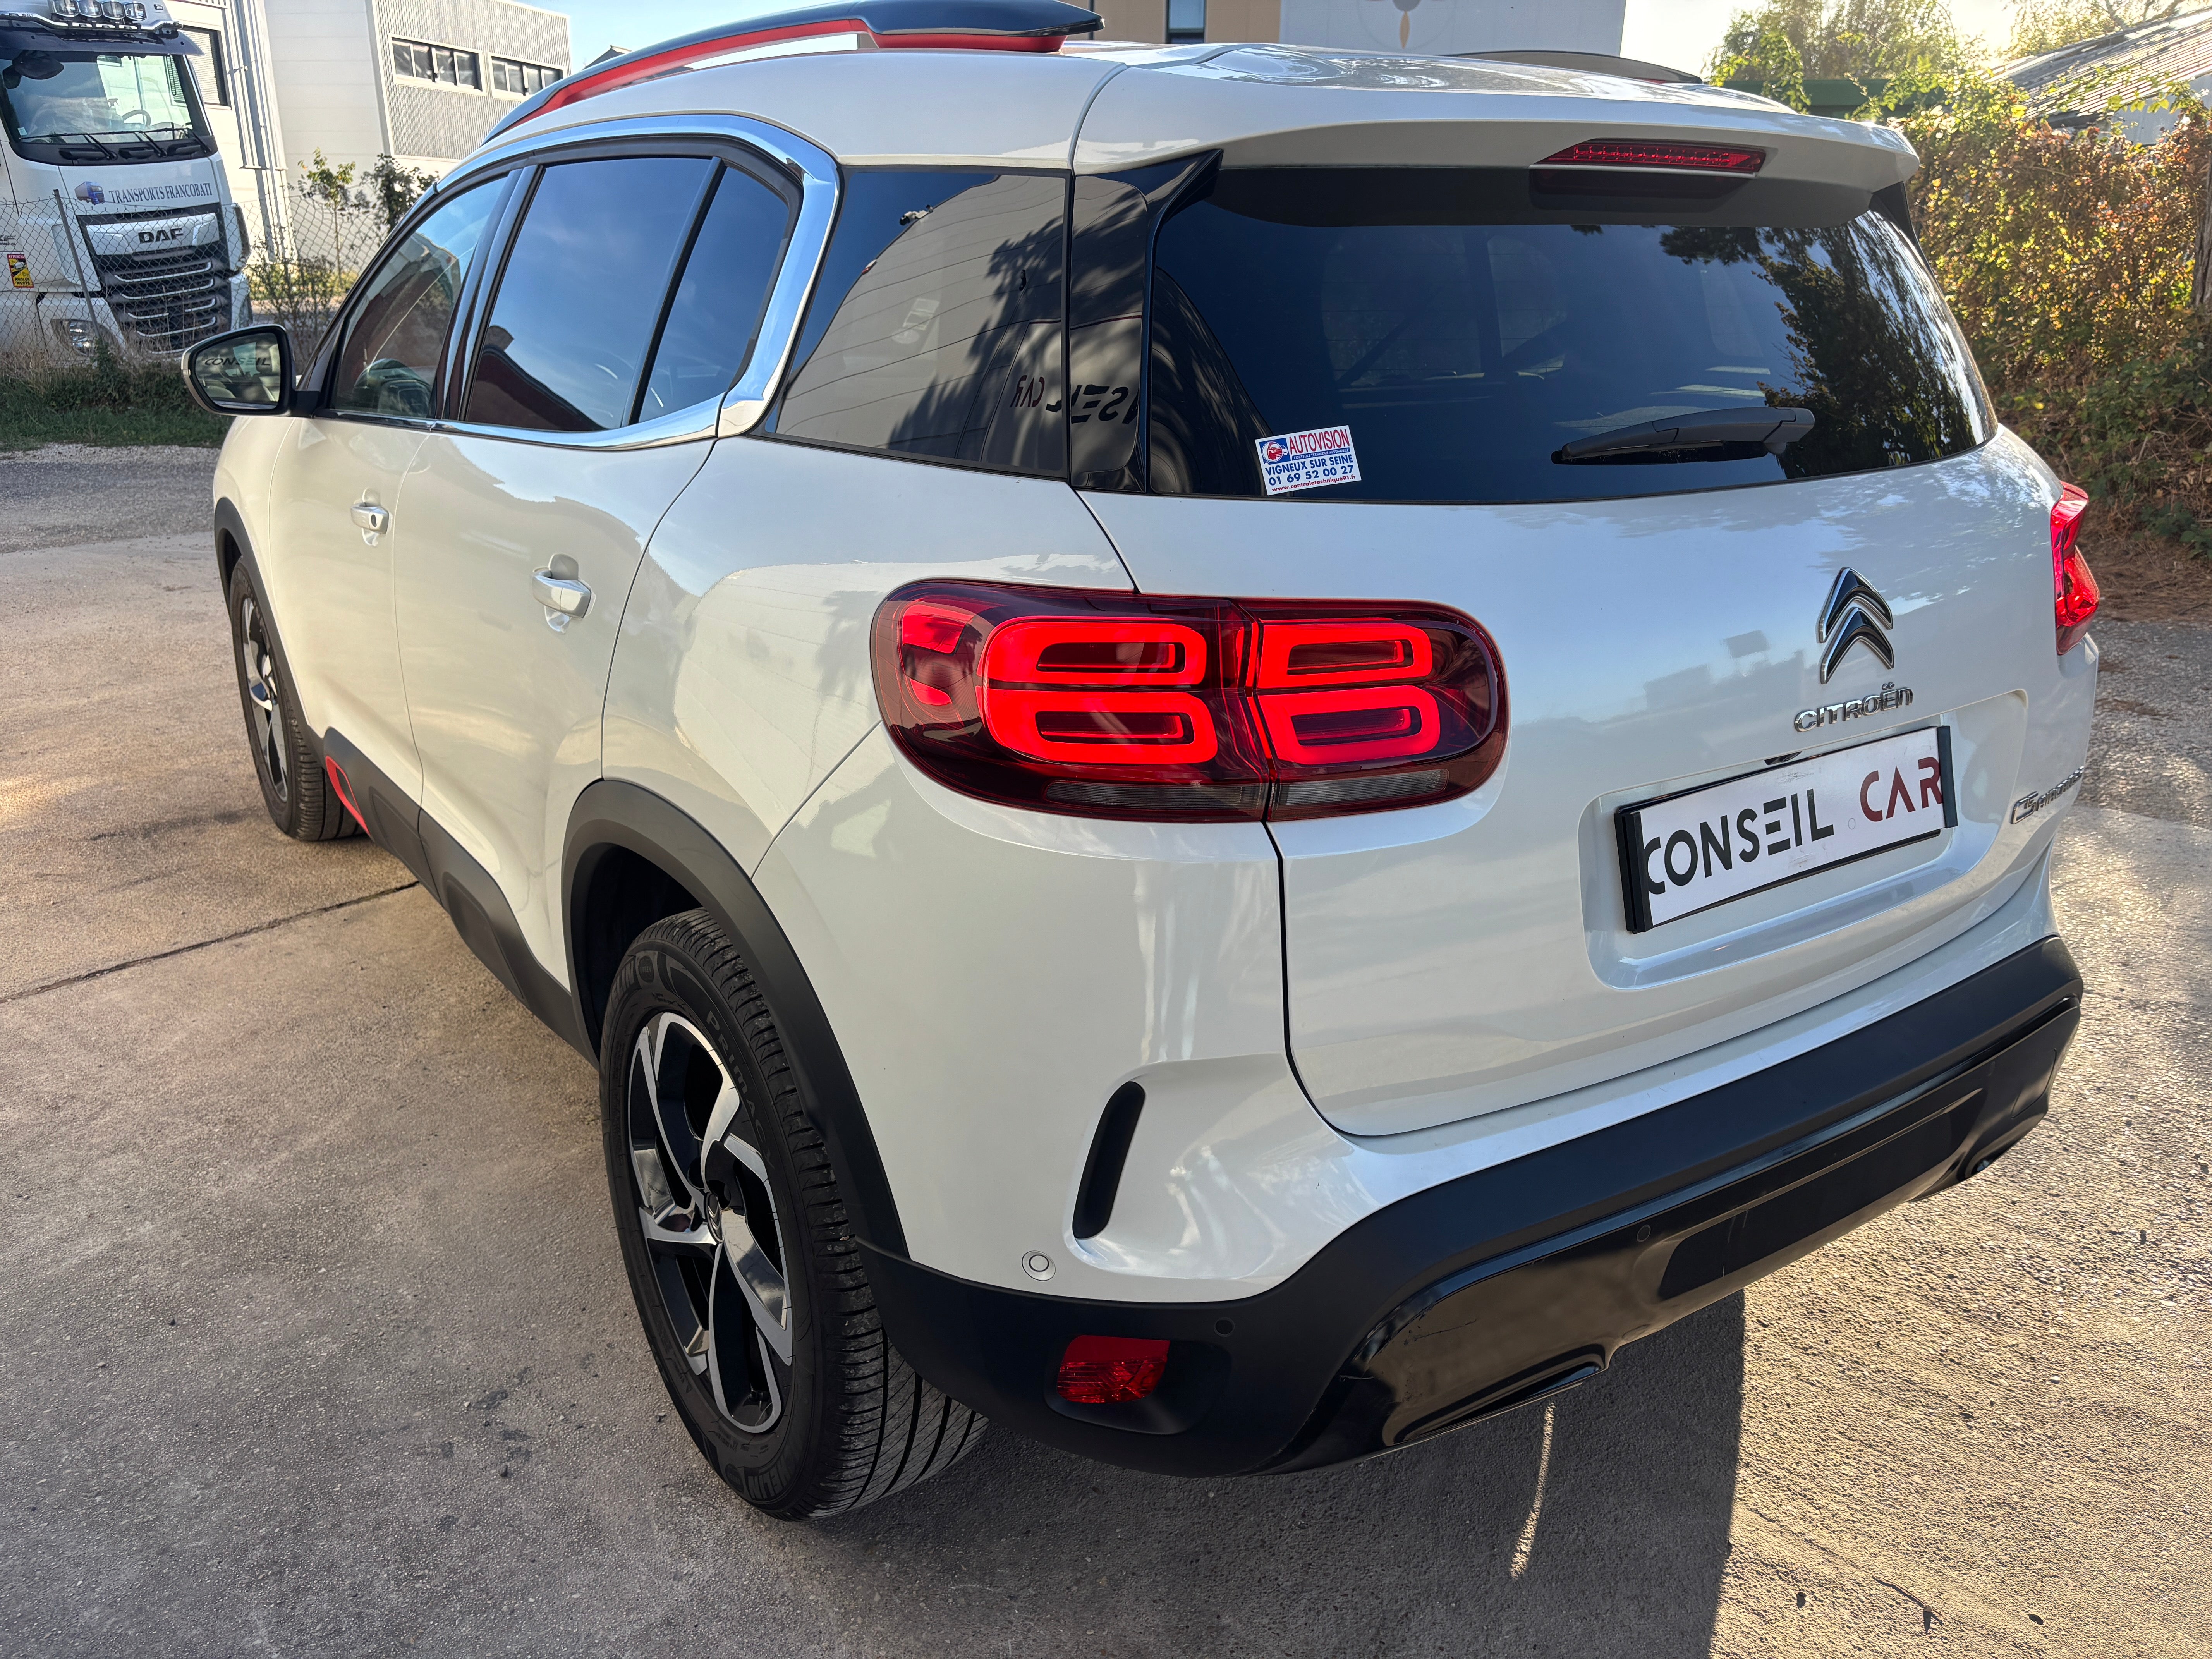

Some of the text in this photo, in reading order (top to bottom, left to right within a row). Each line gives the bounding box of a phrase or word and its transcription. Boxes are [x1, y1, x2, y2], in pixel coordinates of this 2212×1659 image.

[109, 182, 213, 204] TRANSPORTS FRANCOBATI
[137, 226, 184, 244] DAF
[204, 357, 271, 366] CONSEIL
[1289, 429, 1350, 455] AUTOVISION
[1265, 454, 1353, 476] VIGNEUX SUR SEINE
[1269, 465, 1354, 486] 01 69 52 00 27
[1794, 682, 1913, 732] CITROËN
[1644, 756, 1944, 895] CONSEIL CAR
